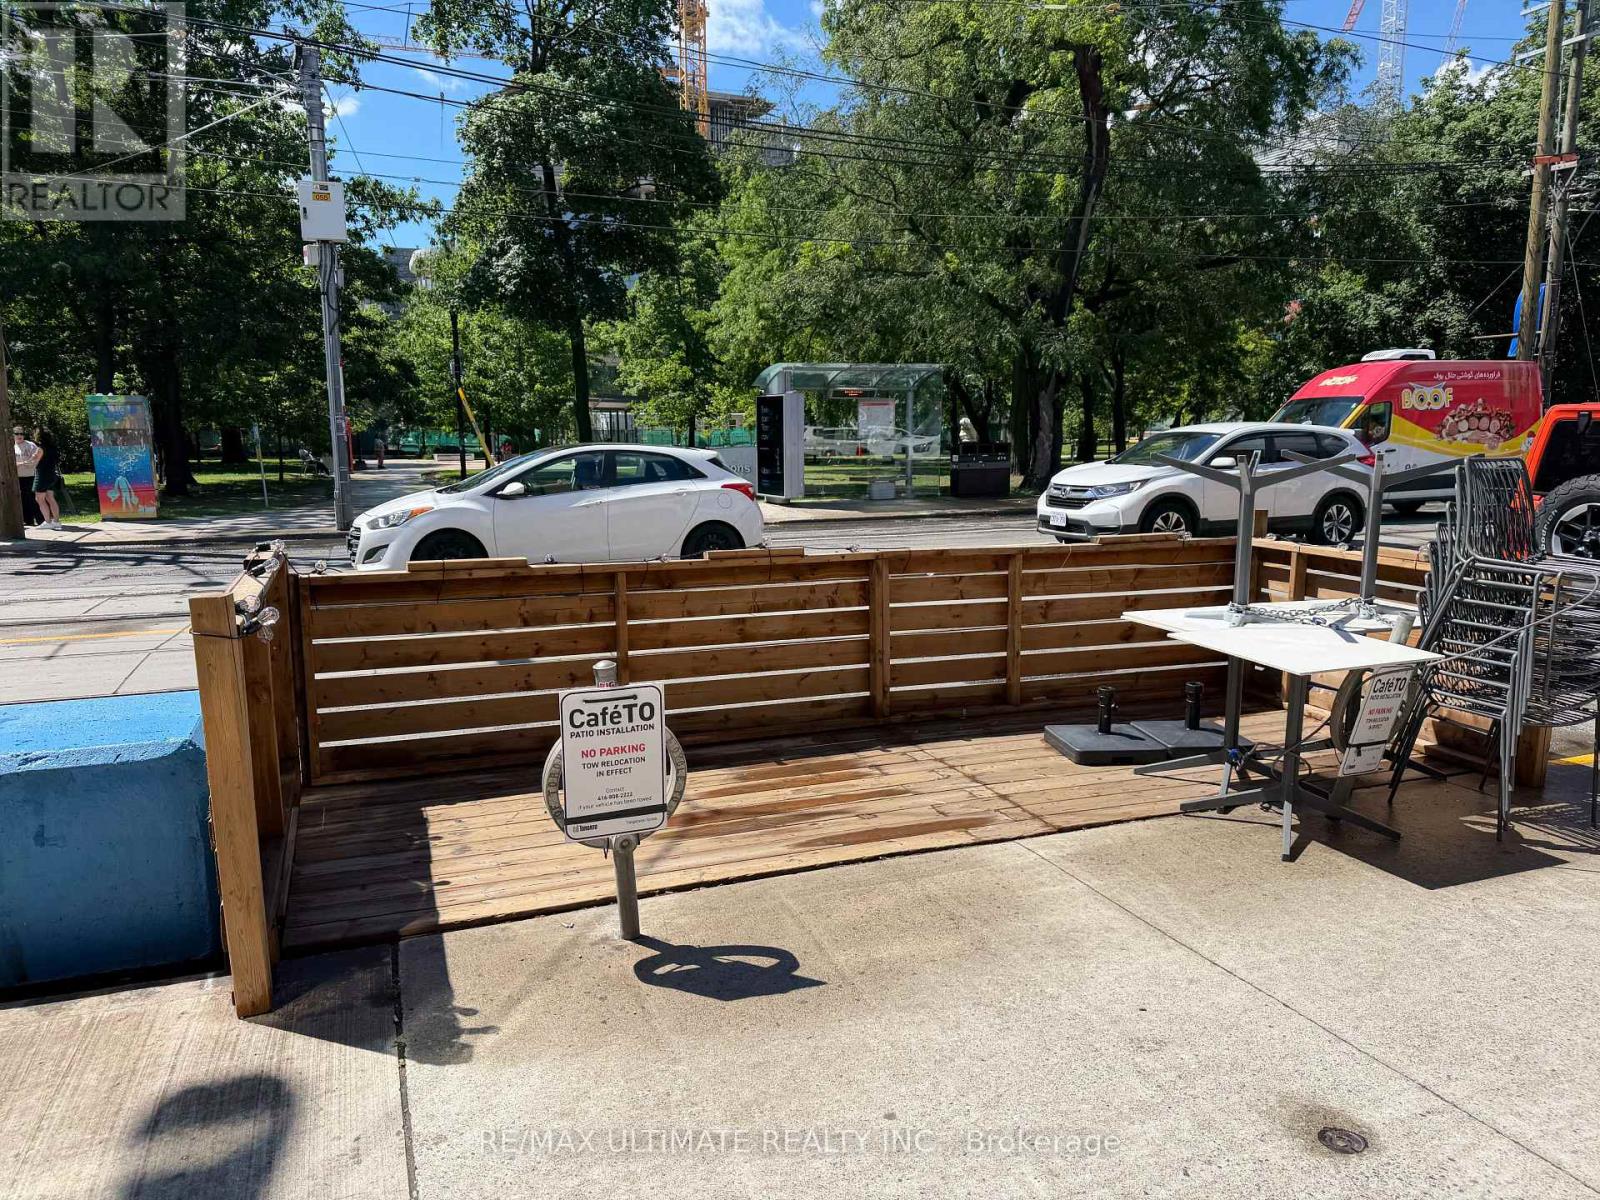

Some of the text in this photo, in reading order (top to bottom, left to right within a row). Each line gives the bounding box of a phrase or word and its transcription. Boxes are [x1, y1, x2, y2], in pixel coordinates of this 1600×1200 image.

[1402, 385, 1453, 410] BOOF
[1373, 677, 1407, 693] CaféTO
[569, 701, 655, 729] CaféTO
[570, 723, 655, 739] PATIO INSTALLATION
[581, 743, 646, 759] NO PARKING
[582, 756, 646, 770] TOW RELOCATION
[596, 766, 633, 778] IN EFFECT
